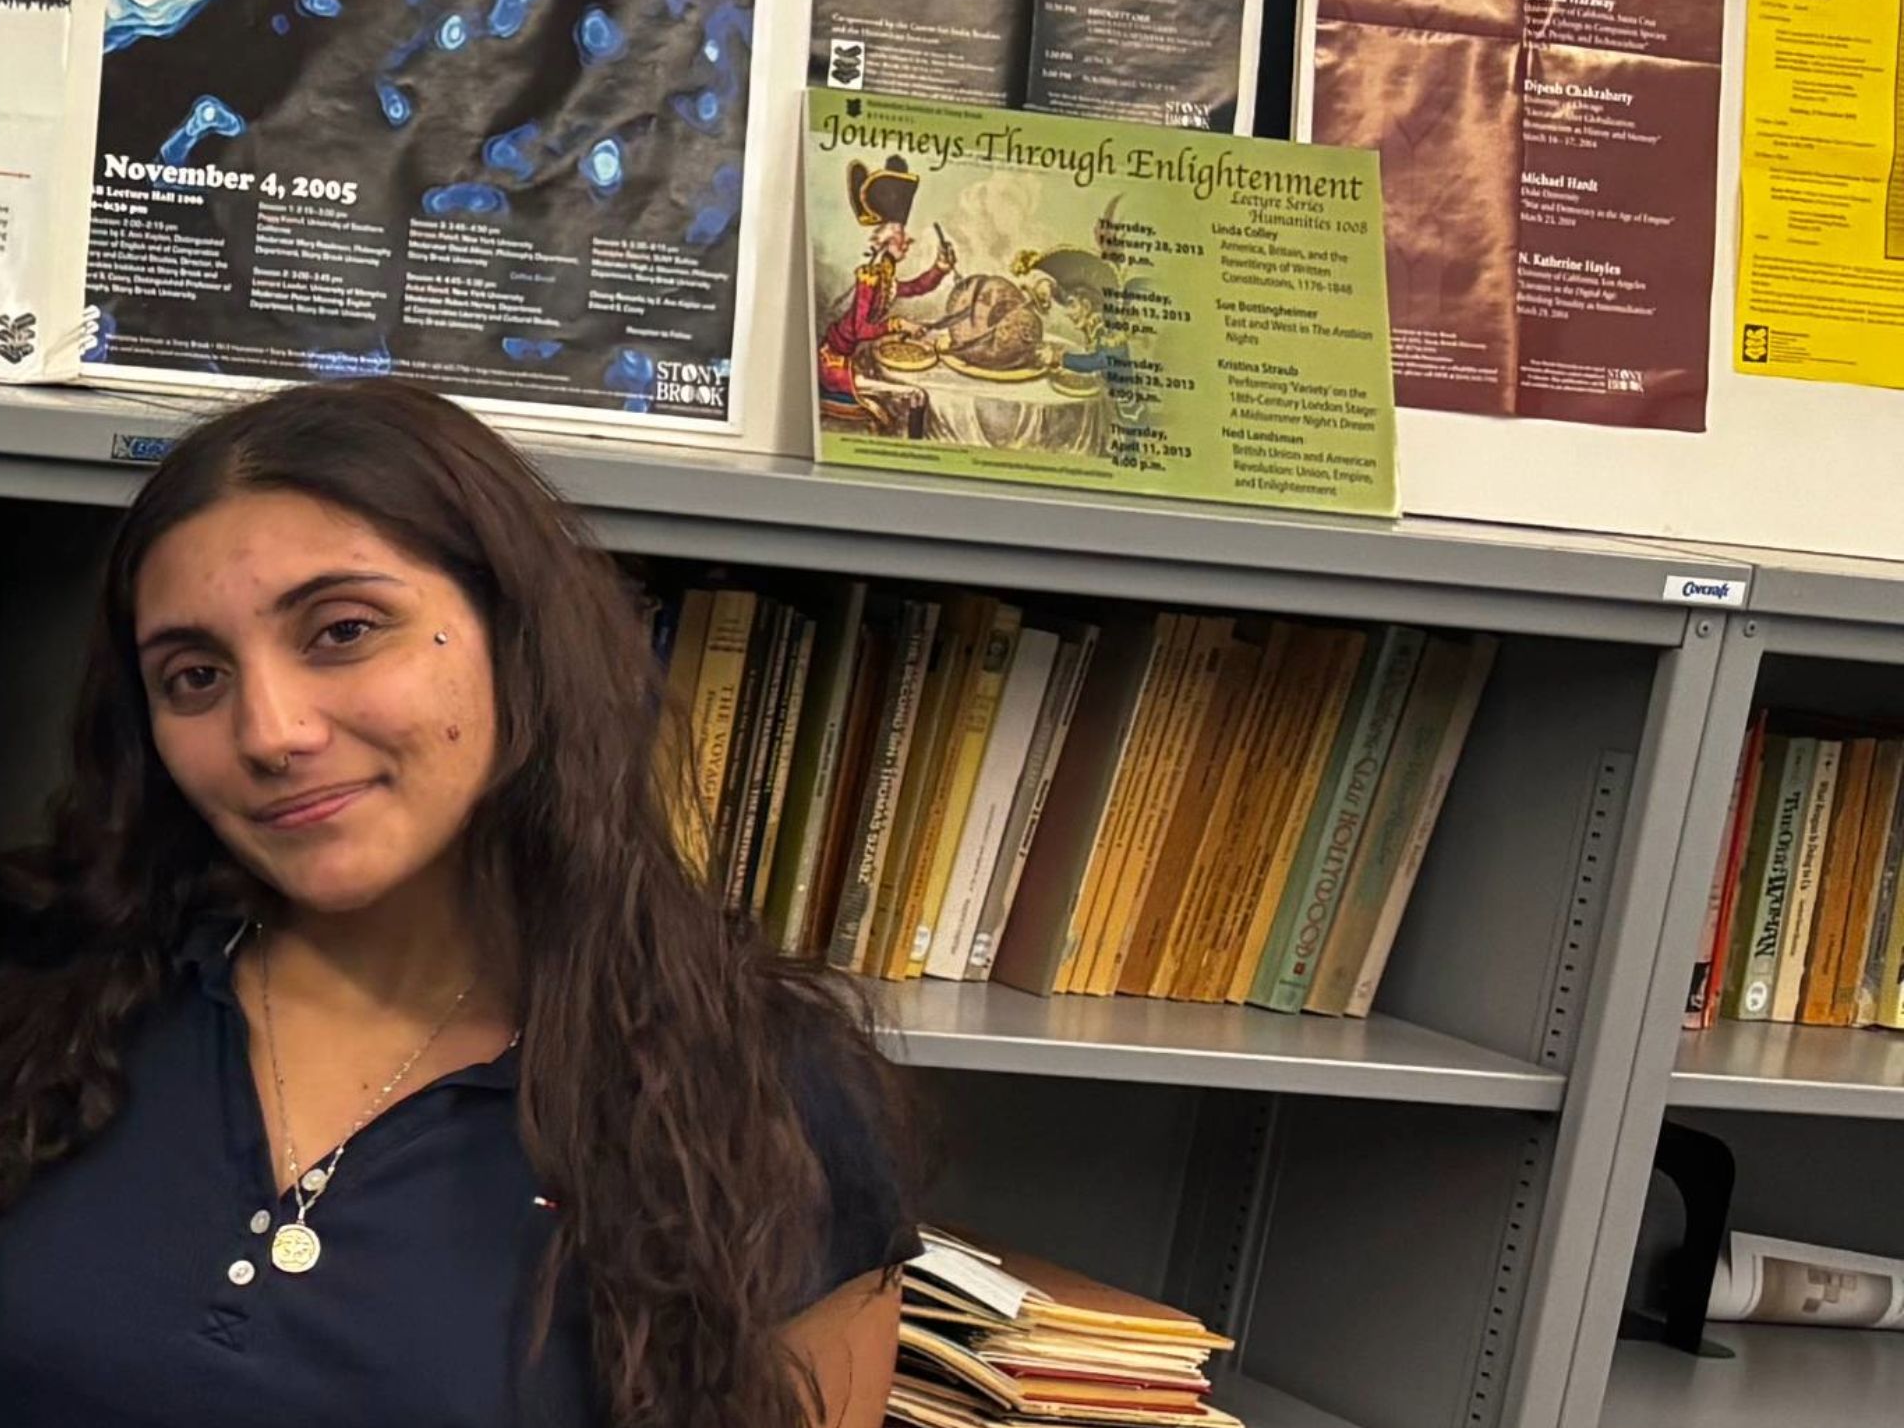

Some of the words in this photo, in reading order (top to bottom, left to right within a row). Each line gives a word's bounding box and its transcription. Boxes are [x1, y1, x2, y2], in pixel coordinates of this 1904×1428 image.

[103, 151, 255, 191] November
[260, 173, 286, 200] 4,
[291, 176, 357, 205] 2005
[820, 114, 965, 172] Journeys
[977, 126, 1117, 187] Through
[1125, 149, 1363, 201] Enlightenment
